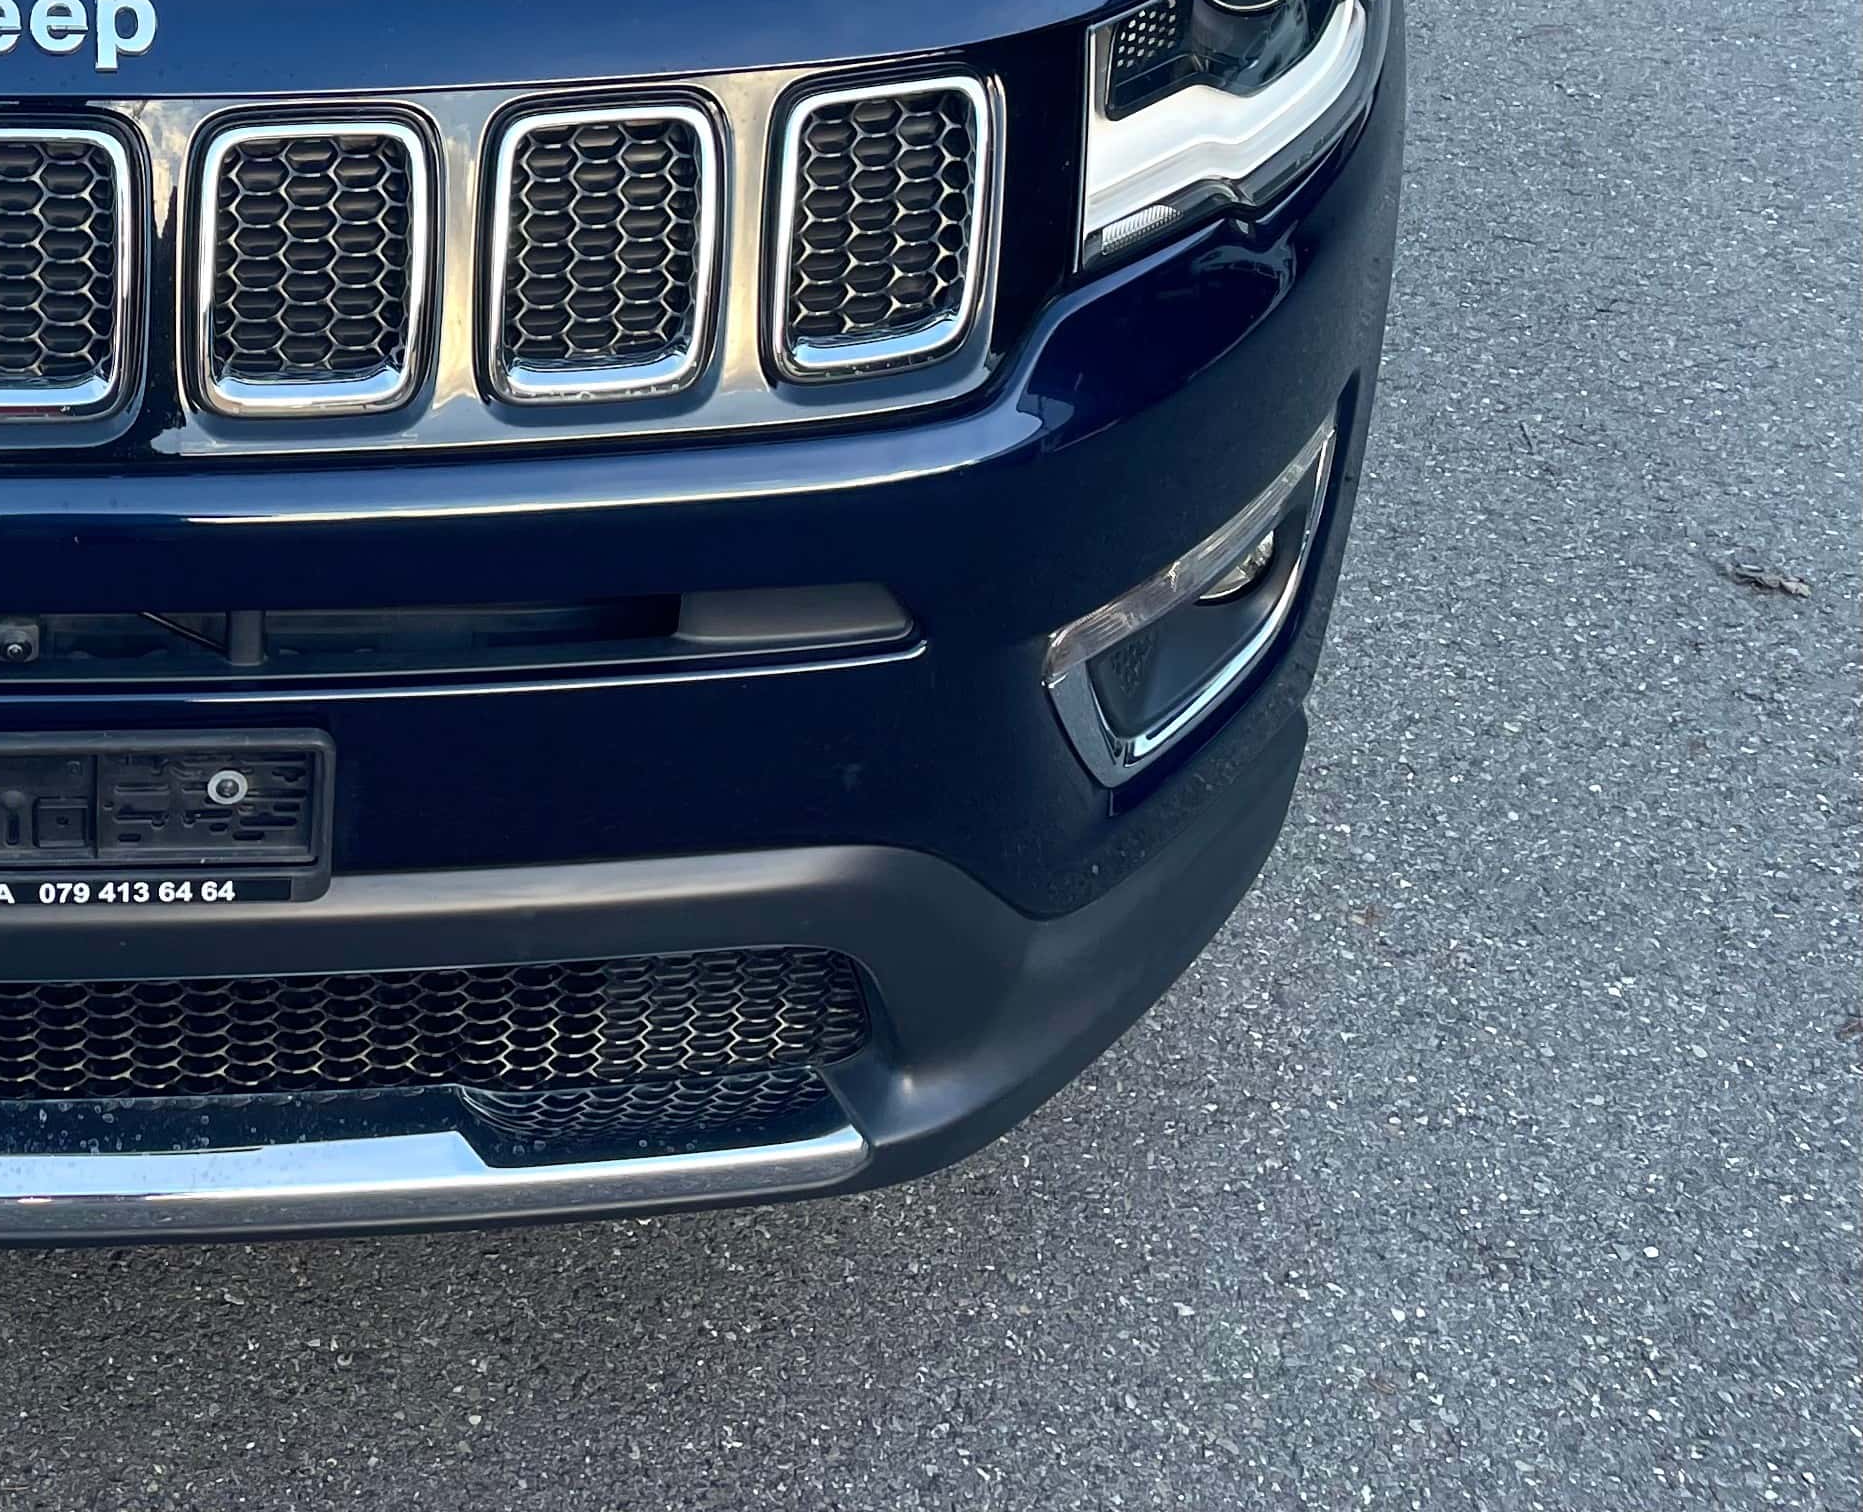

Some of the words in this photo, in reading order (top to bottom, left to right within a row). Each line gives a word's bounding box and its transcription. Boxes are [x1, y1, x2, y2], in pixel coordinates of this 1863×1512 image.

[38, 883, 90, 904] 079
[97, 882, 150, 903] 413
[158, 881, 193, 902] 64
[201, 880, 235, 901] 64
